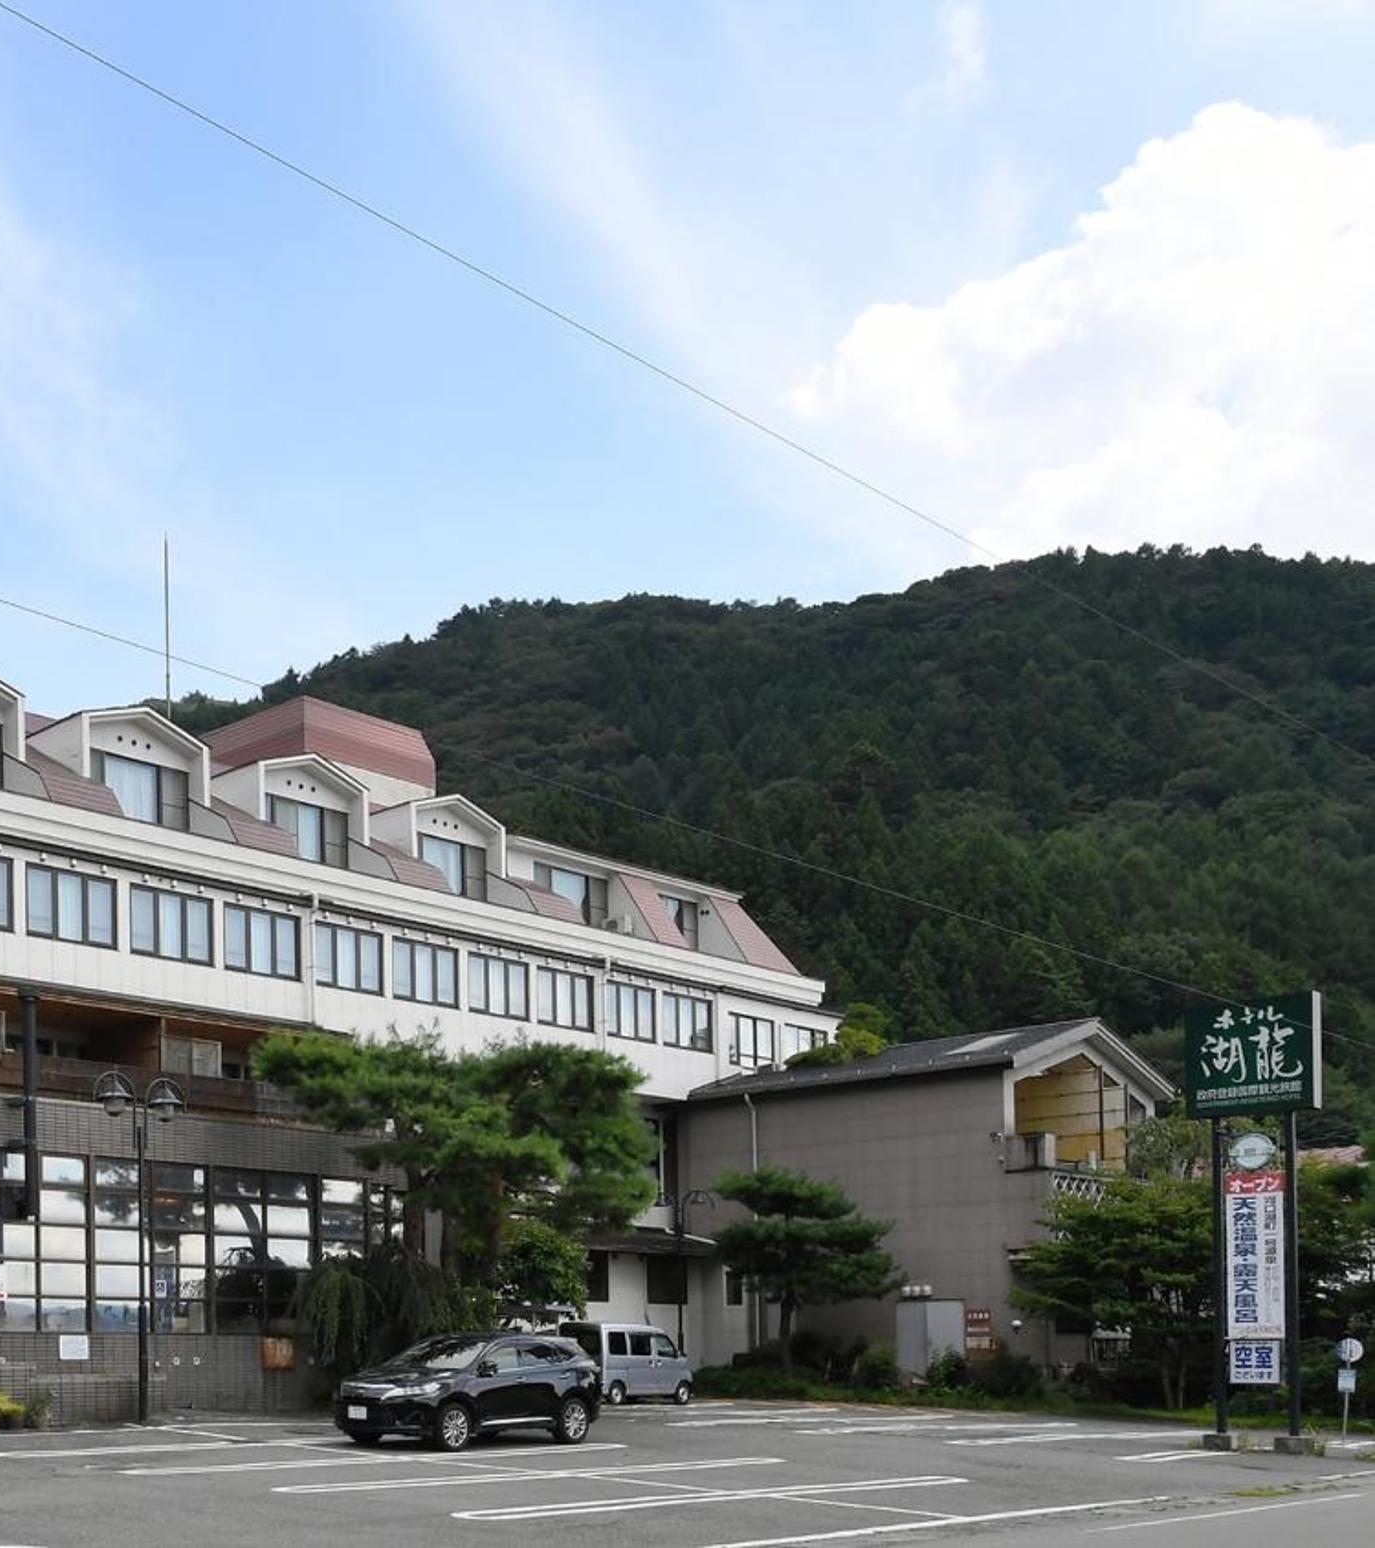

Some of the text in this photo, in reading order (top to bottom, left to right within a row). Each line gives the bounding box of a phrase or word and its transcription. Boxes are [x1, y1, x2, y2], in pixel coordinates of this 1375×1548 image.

[1212, 1005, 1284, 1030] ホテル
[1200, 1023, 1304, 1083] 湖龍
[1229, 1176, 1280, 1193] オープン
[1234, 1345, 1273, 1369] 空室
